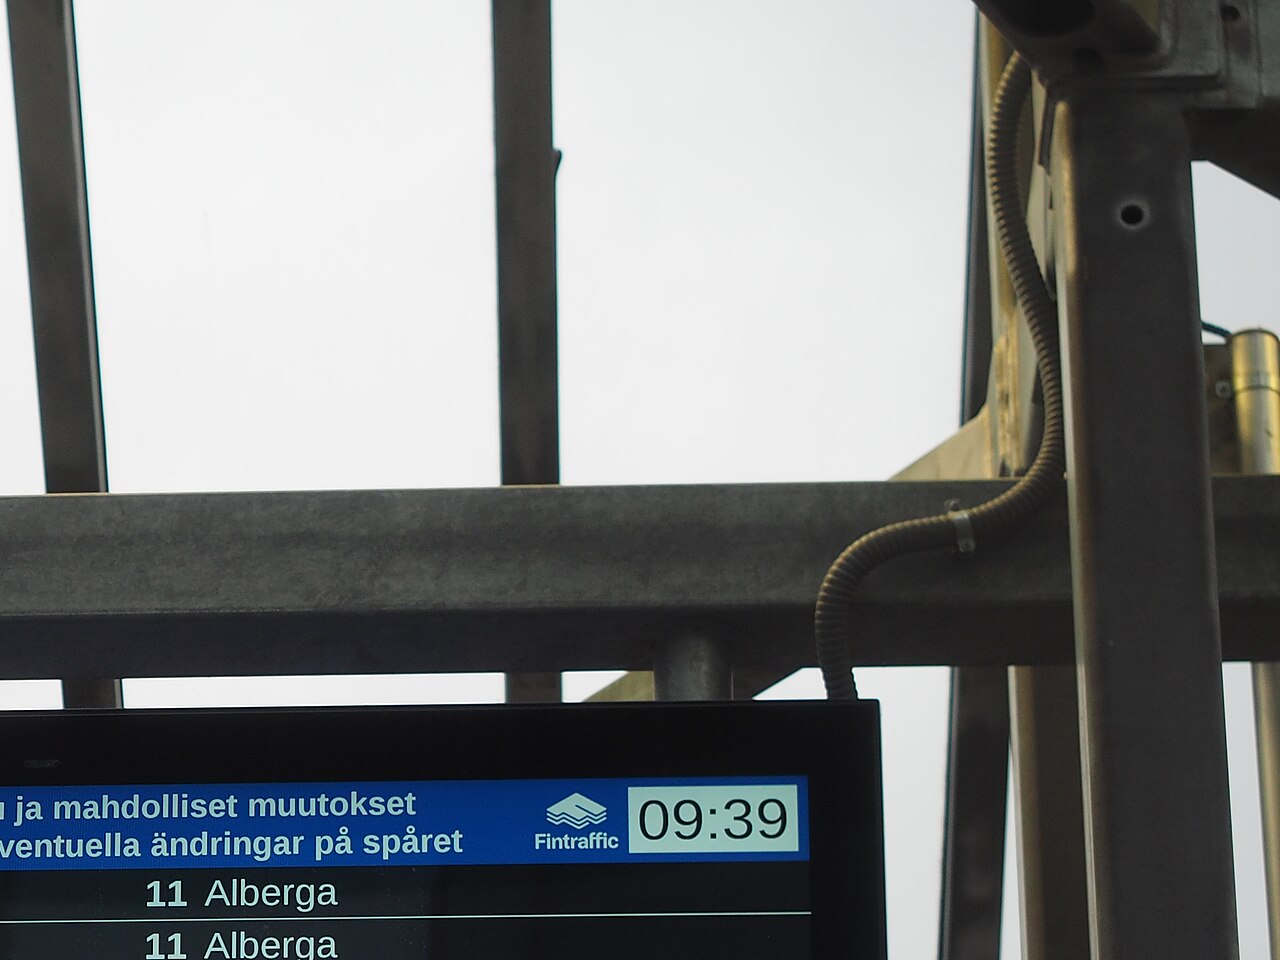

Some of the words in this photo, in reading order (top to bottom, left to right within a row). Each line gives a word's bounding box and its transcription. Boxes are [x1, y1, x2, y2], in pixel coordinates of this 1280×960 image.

[14, 796, 43, 826] ja
[54, 794, 237, 819] mahdolliset
[249, 791, 416, 816] muutokset
[640, 799, 786, 840] 09:39
[151, 831, 304, 861] ändringar
[316, 827, 353, 860] på
[363, 826, 463, 860] spåret
[535, 832, 618, 849] Fintraffic
[147, 881, 187, 906] 11
[205, 879, 338, 912] Alberga
[146, 933, 186, 959] 11
